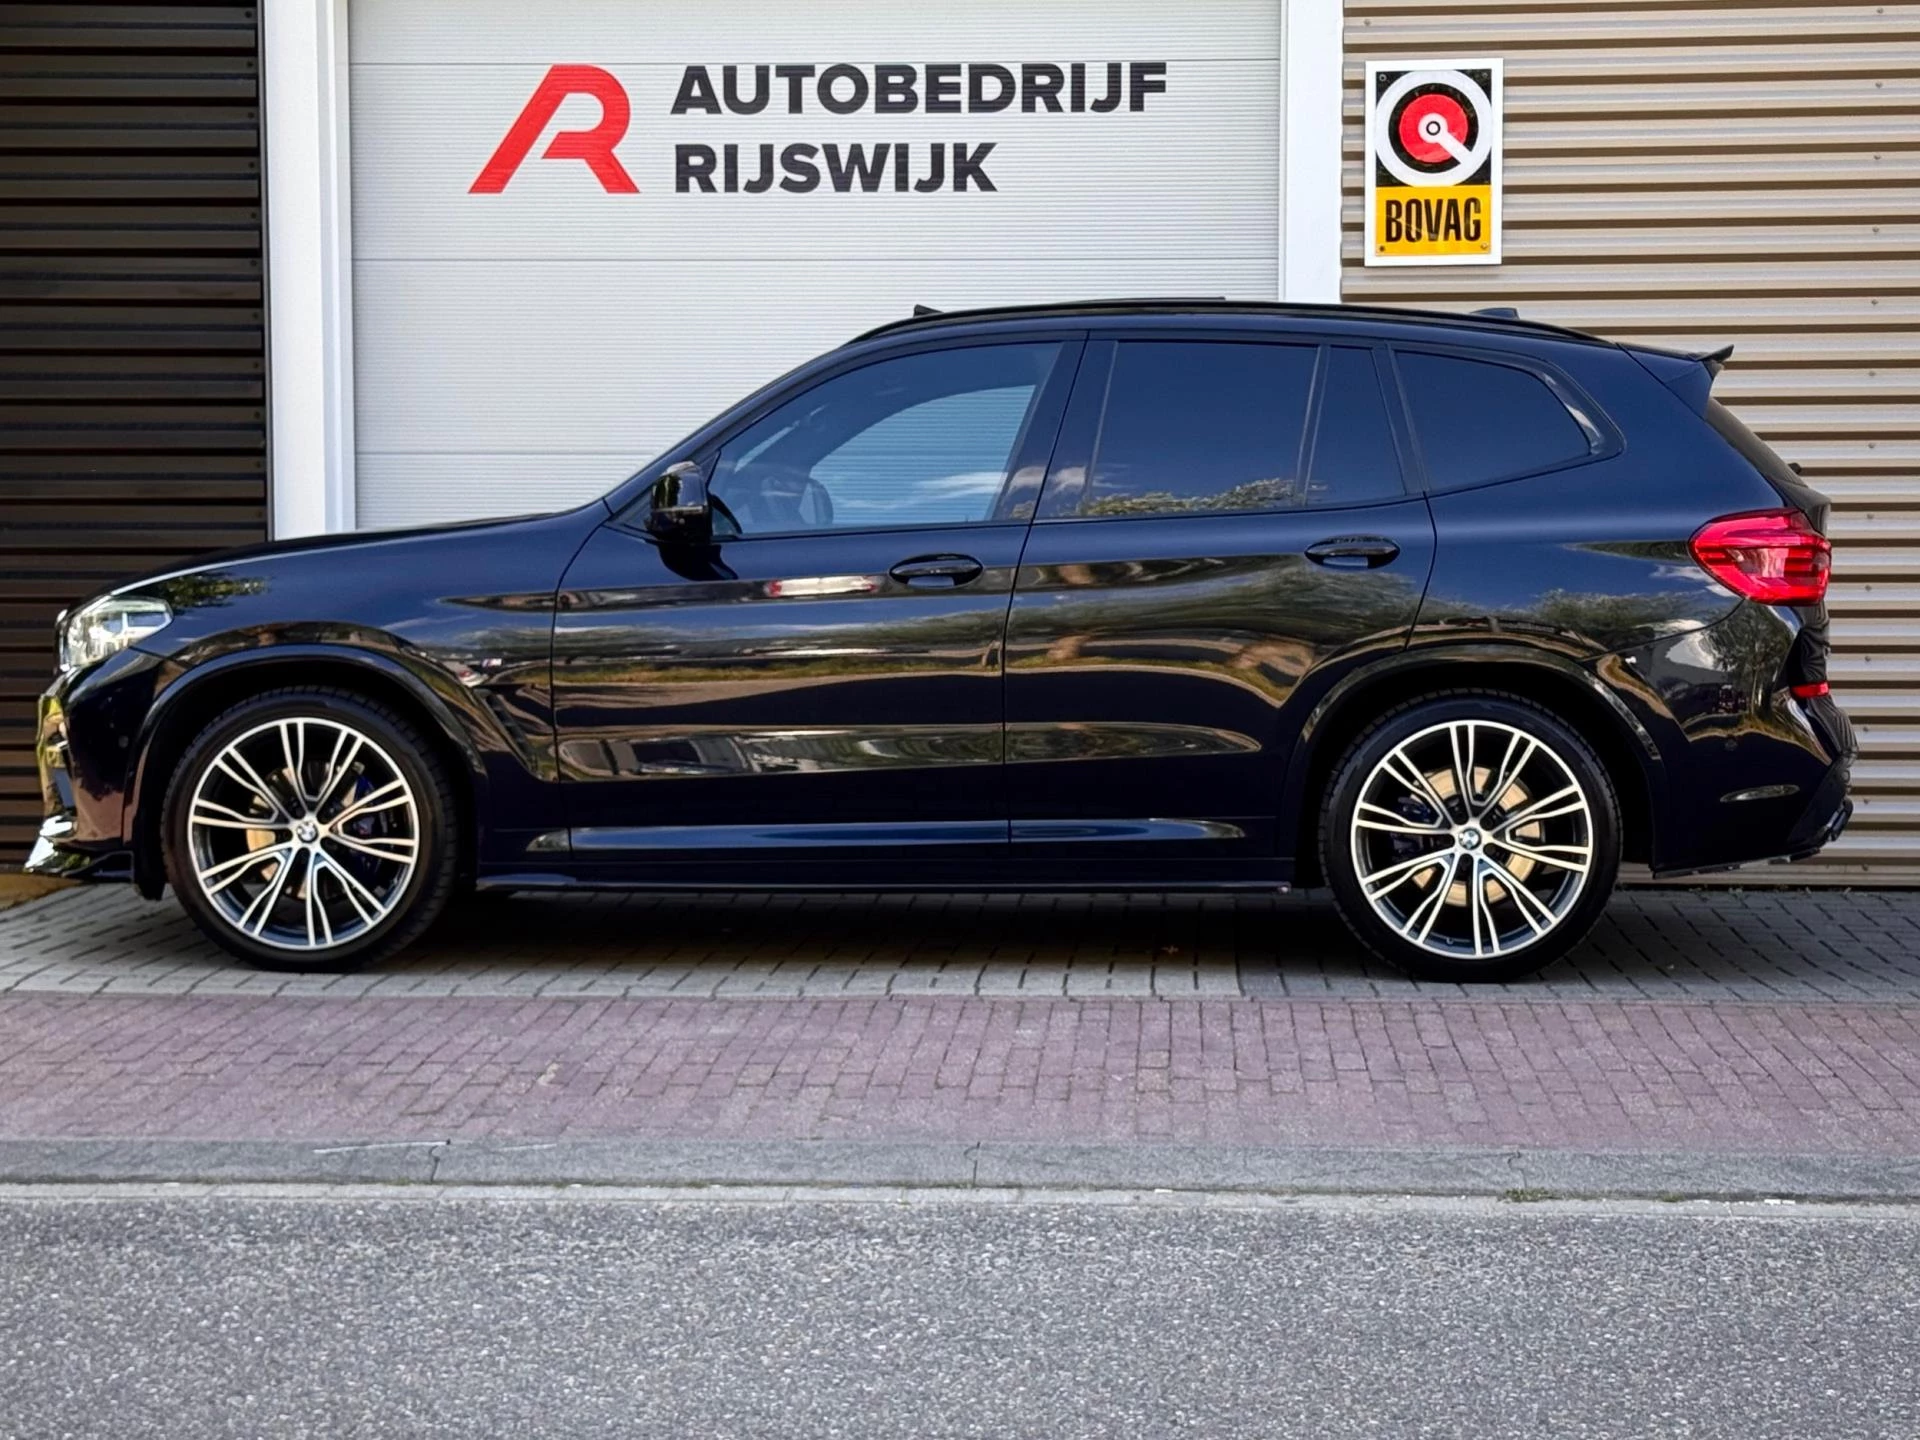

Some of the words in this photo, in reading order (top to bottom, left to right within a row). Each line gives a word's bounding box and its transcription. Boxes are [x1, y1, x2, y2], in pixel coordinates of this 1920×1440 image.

[670, 61, 1167, 115] AUTOBEDRIJF
[675, 142, 997, 194] RIJSWIJK
[1385, 197, 1482, 243] BOVAG
